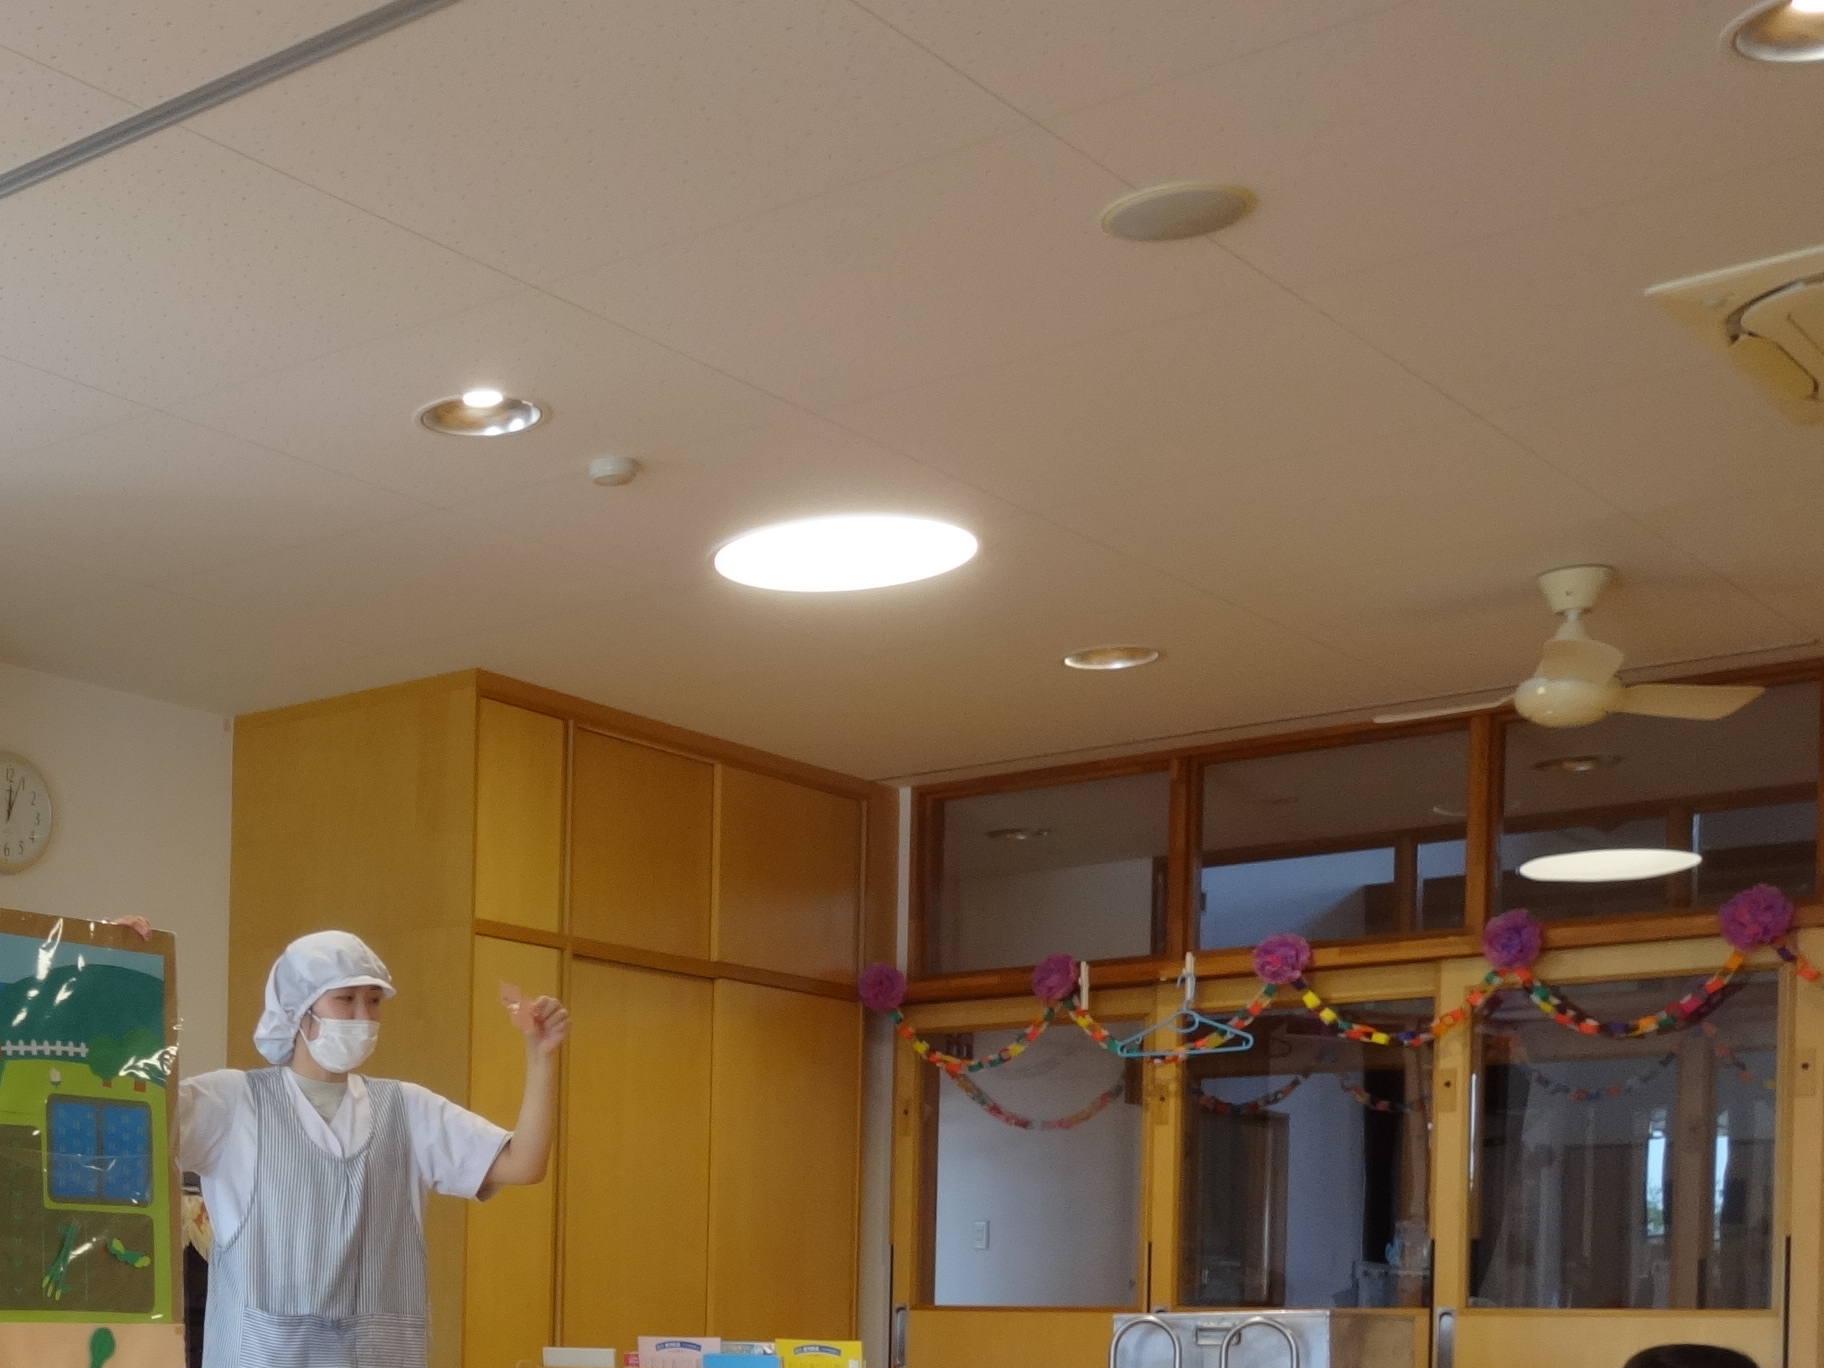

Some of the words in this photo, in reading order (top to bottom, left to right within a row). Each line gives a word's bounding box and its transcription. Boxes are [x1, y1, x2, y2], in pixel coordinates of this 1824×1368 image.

[6, 767, 15, 783] 12
[31, 790, 36, 806] 2
[34, 811, 40, 826] 3
[29, 830, 35, 844] 4
[4, 842, 10, 856] 6
[18, 841, 24, 855] 5
